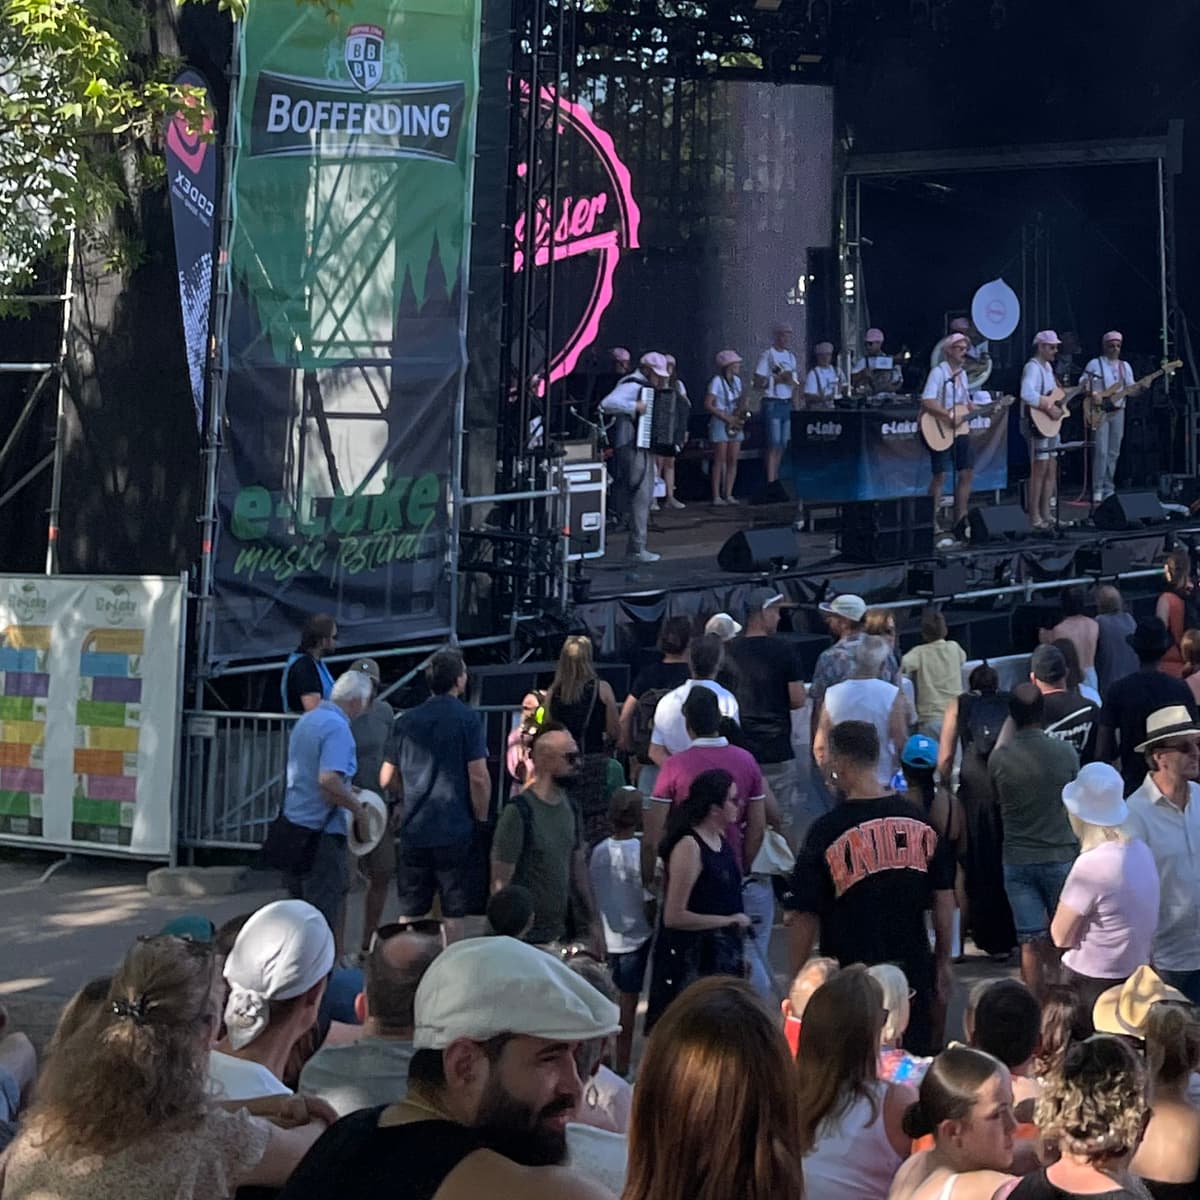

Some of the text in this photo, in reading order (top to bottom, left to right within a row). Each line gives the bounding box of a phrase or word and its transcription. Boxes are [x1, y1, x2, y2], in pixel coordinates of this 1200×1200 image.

[266, 93, 450, 138] BOFFERDING
[806, 421, 843, 435] e-Lake
[880, 421, 919, 435] e-Lake
